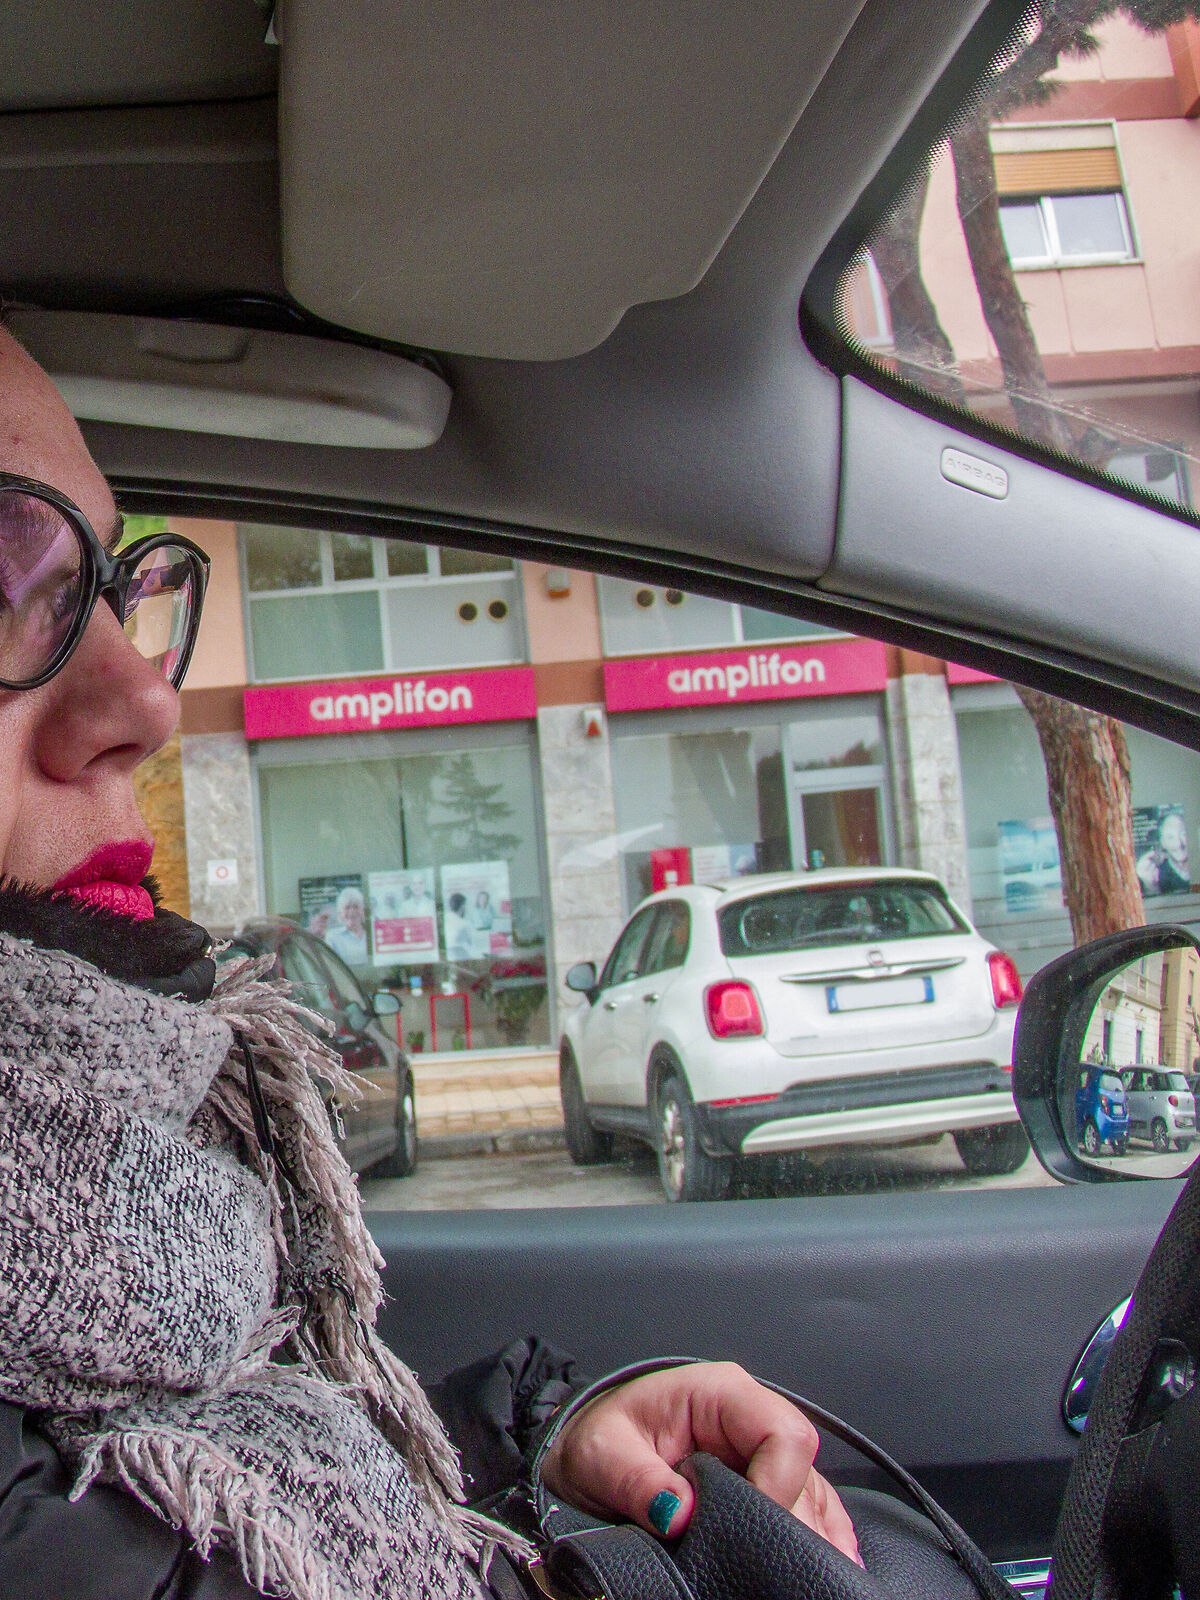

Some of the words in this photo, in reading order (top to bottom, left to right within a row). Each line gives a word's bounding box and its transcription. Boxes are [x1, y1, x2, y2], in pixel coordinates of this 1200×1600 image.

[945, 457, 1007, 487] AIRBAG
[667, 653, 826, 698] amplifon
[309, 680, 473, 726] amplifon
